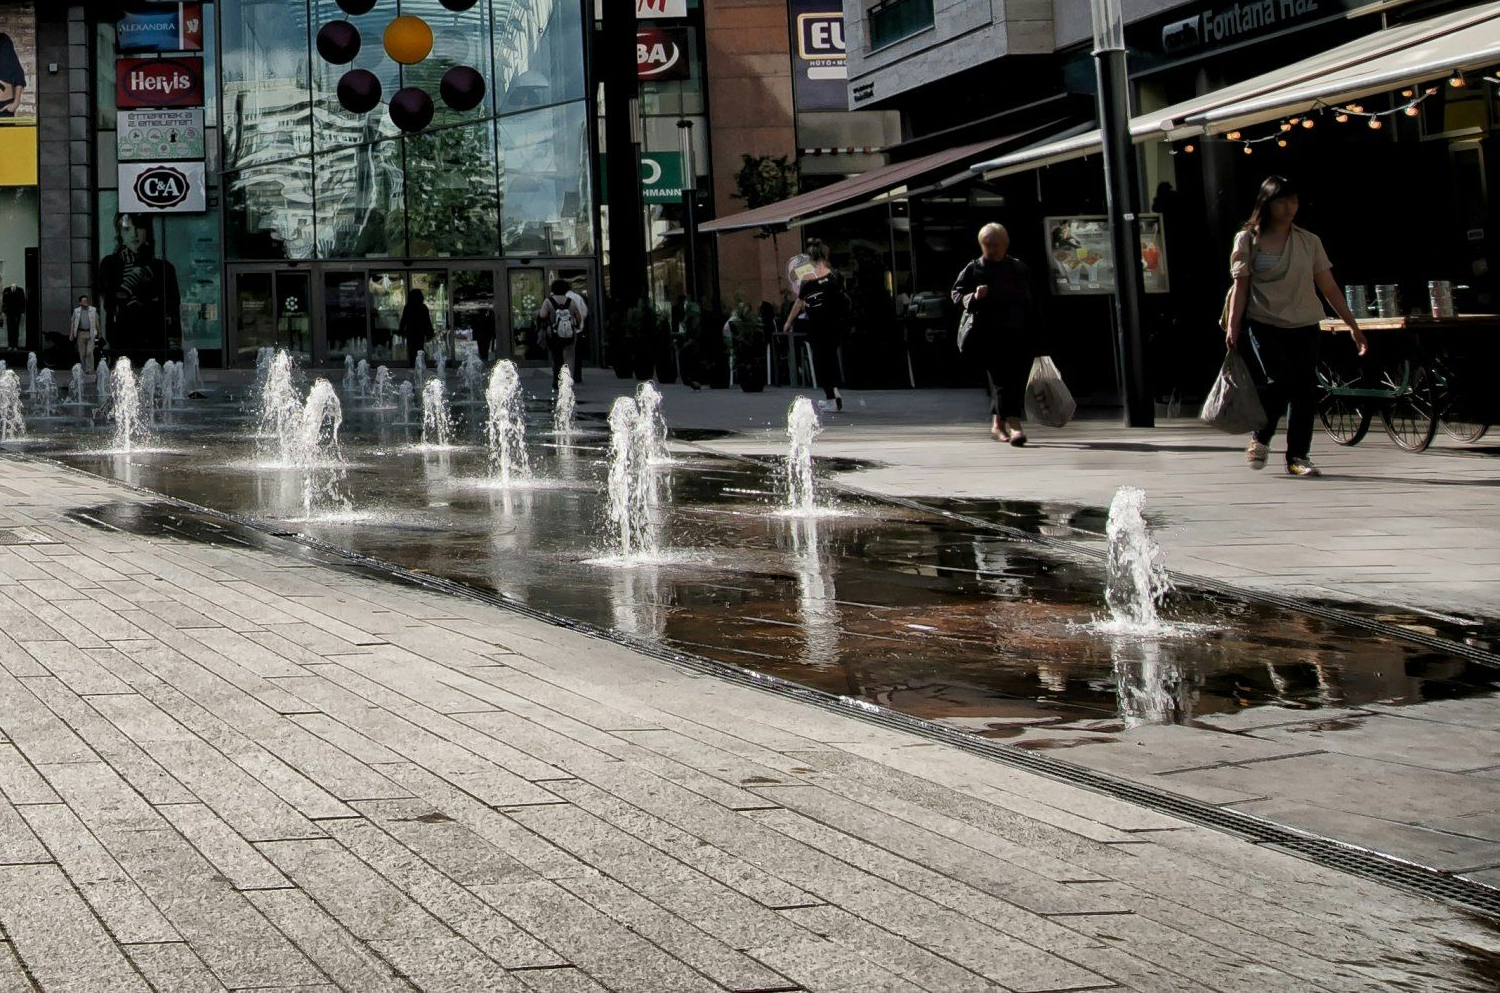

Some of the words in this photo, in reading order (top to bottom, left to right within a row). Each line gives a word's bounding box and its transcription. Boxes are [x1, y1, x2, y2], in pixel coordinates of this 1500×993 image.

[119, 22, 176, 32] ALEXANDRA
[637, 43, 668, 64] BA
[131, 71, 191, 94] Hervis
[143, 177, 180, 197] C&A
[642, 188, 682, 197] HMANN
